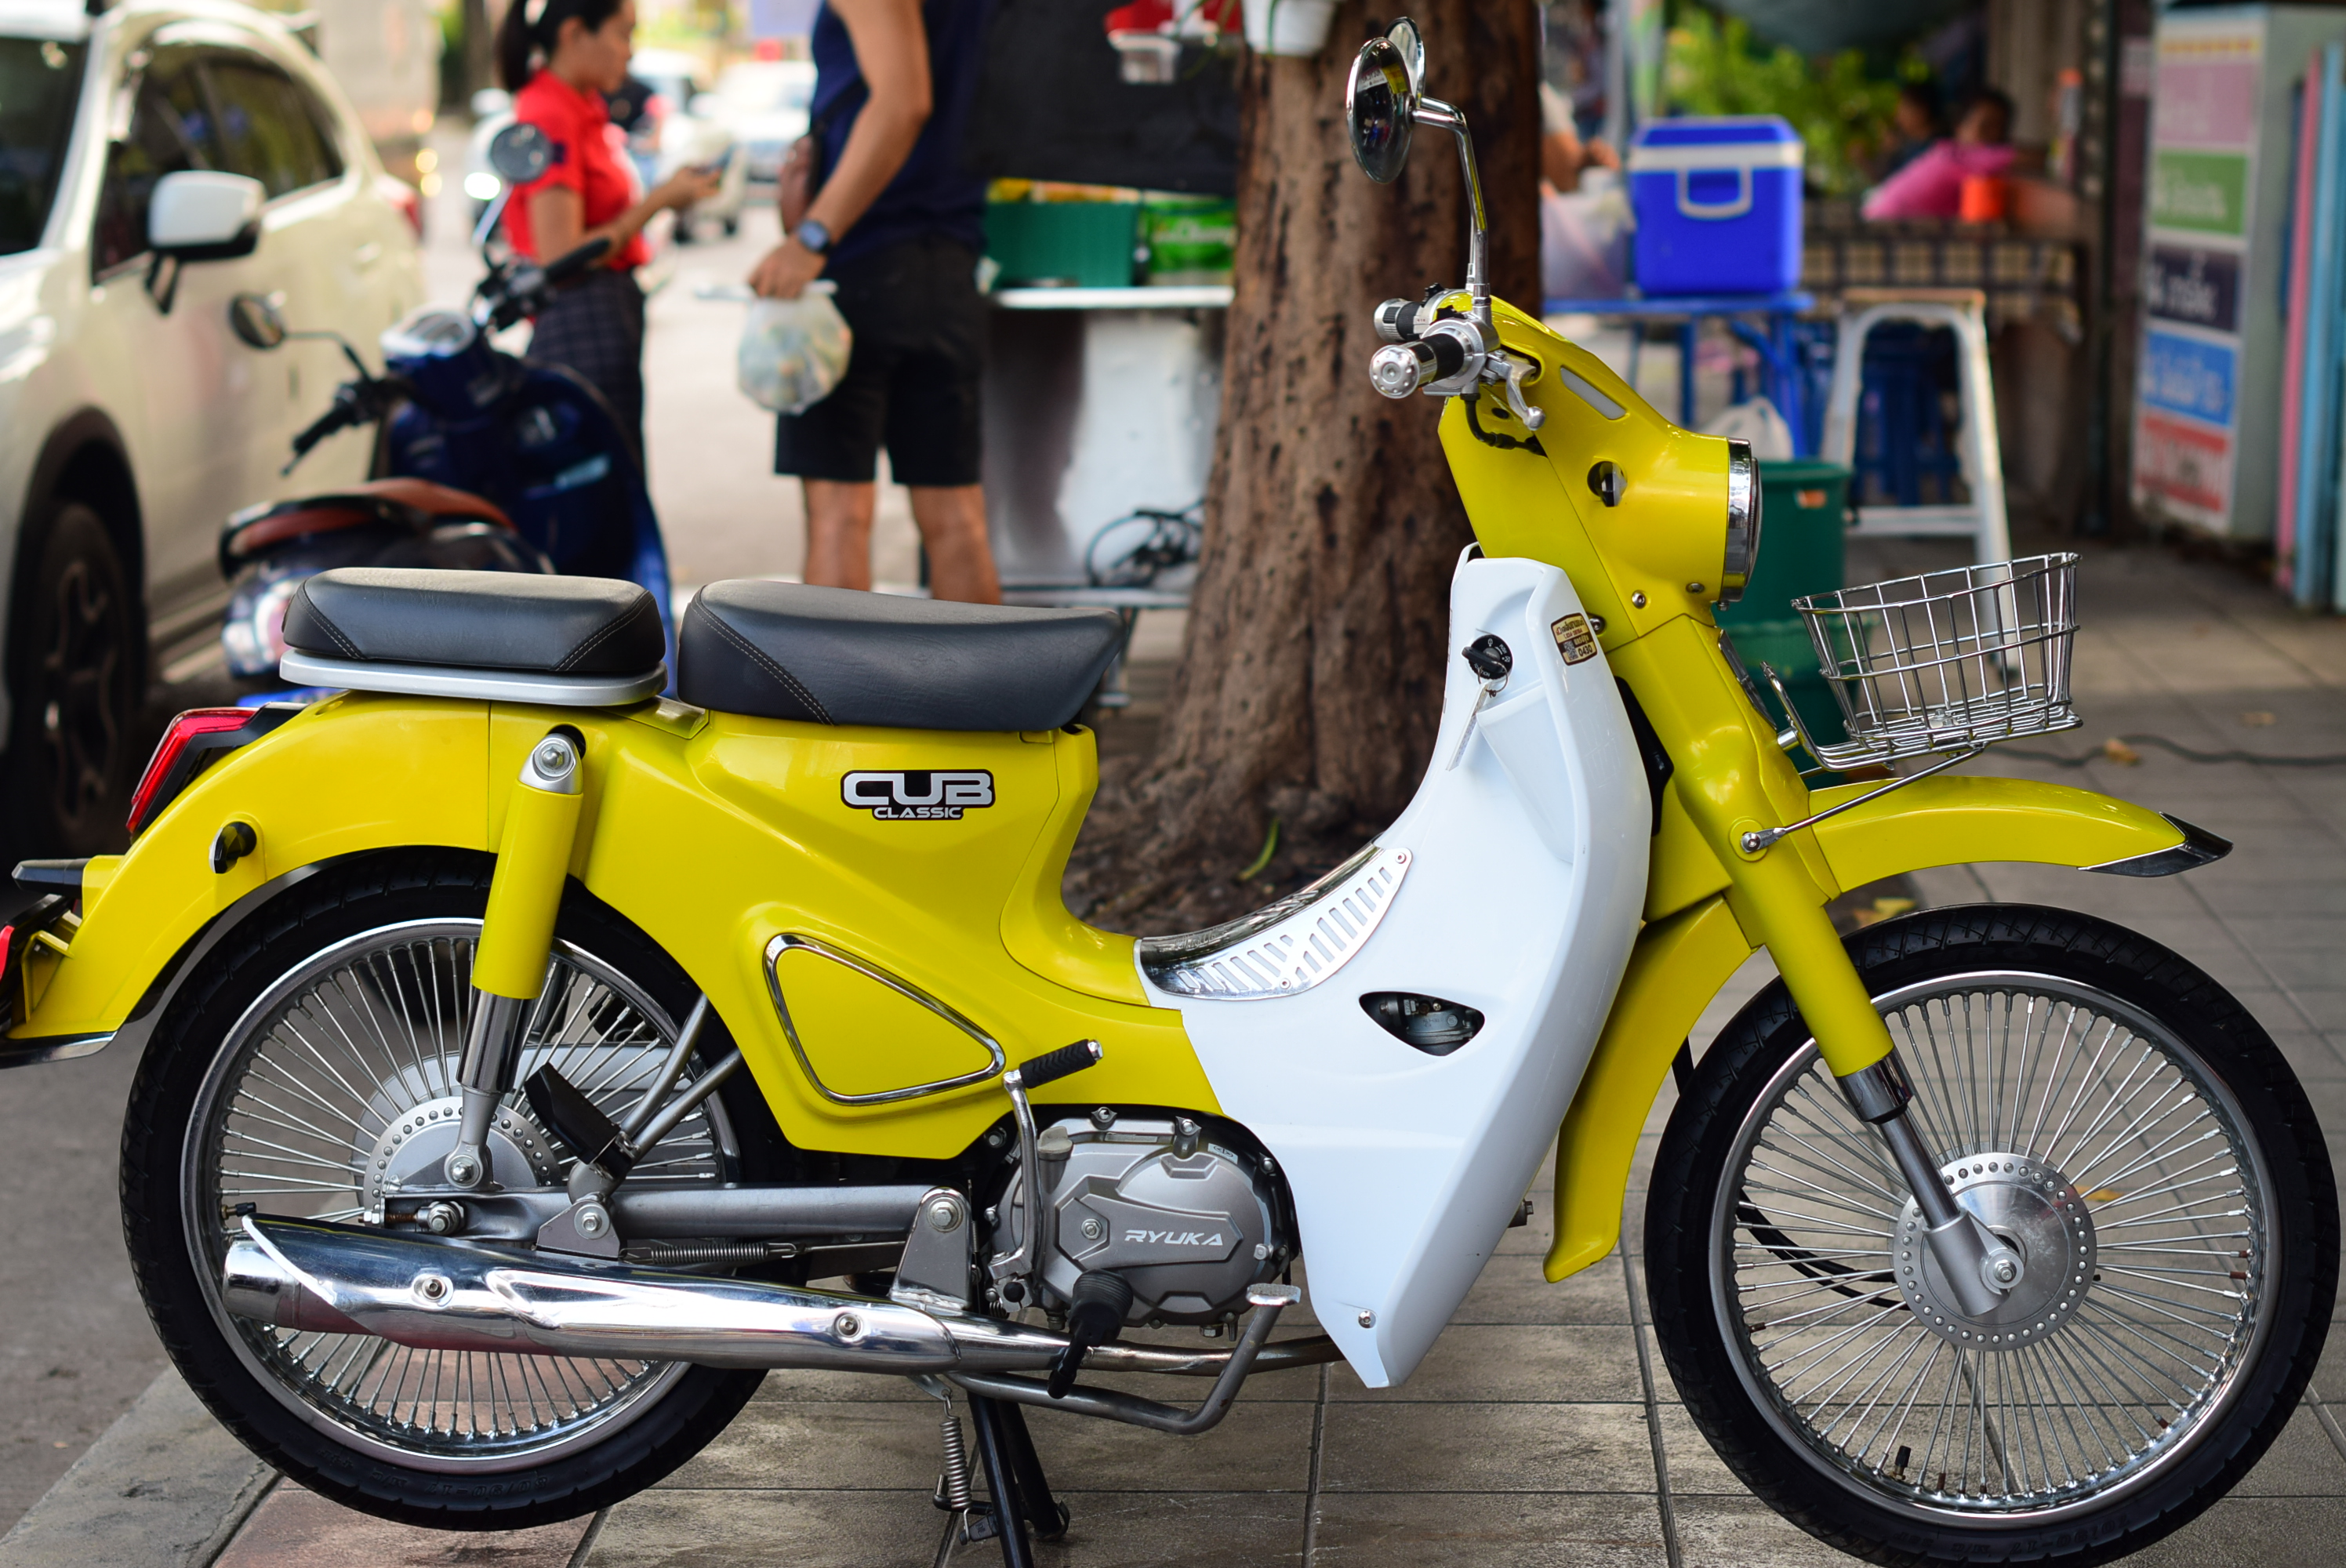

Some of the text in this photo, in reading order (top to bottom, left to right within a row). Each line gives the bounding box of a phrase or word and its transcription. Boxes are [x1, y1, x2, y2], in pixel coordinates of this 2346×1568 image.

[1578, 644, 1593, 657] 0430
[843, 772, 993, 805] CUB
[873, 807, 962, 818] CLASSIC
[1124, 1229, 1223, 1246] RYUKA
